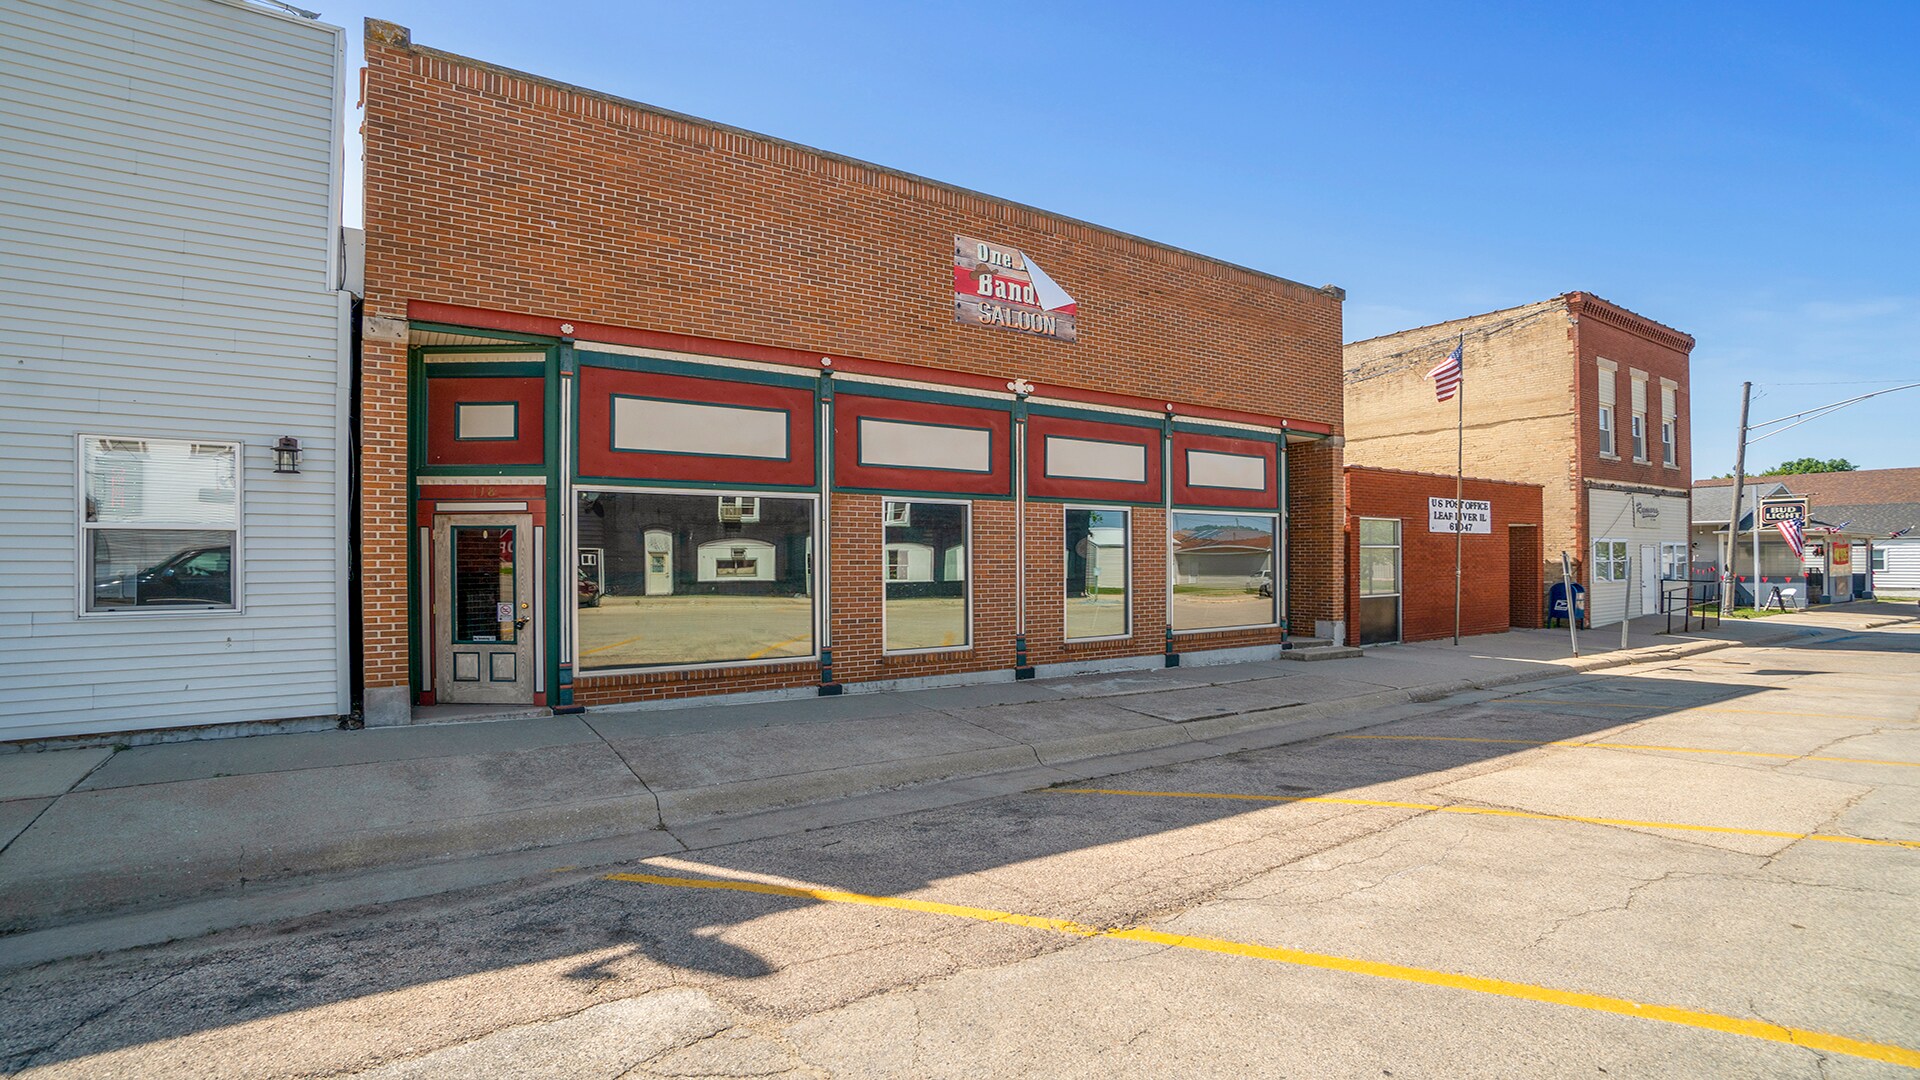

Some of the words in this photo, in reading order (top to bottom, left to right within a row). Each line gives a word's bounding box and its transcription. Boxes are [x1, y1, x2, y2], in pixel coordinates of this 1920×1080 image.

[977, 243, 1013, 268] One
[977, 273, 1041, 308] Band
[977, 301, 1057, 336] SALOON
[1431, 499, 1443, 508] US
[1465, 501, 1489, 511] OFFICE
[1434, 511, 1454, 520] LEAF
[1479, 513, 1487, 522] IL
[1765, 512, 1802, 520] LIGHT
